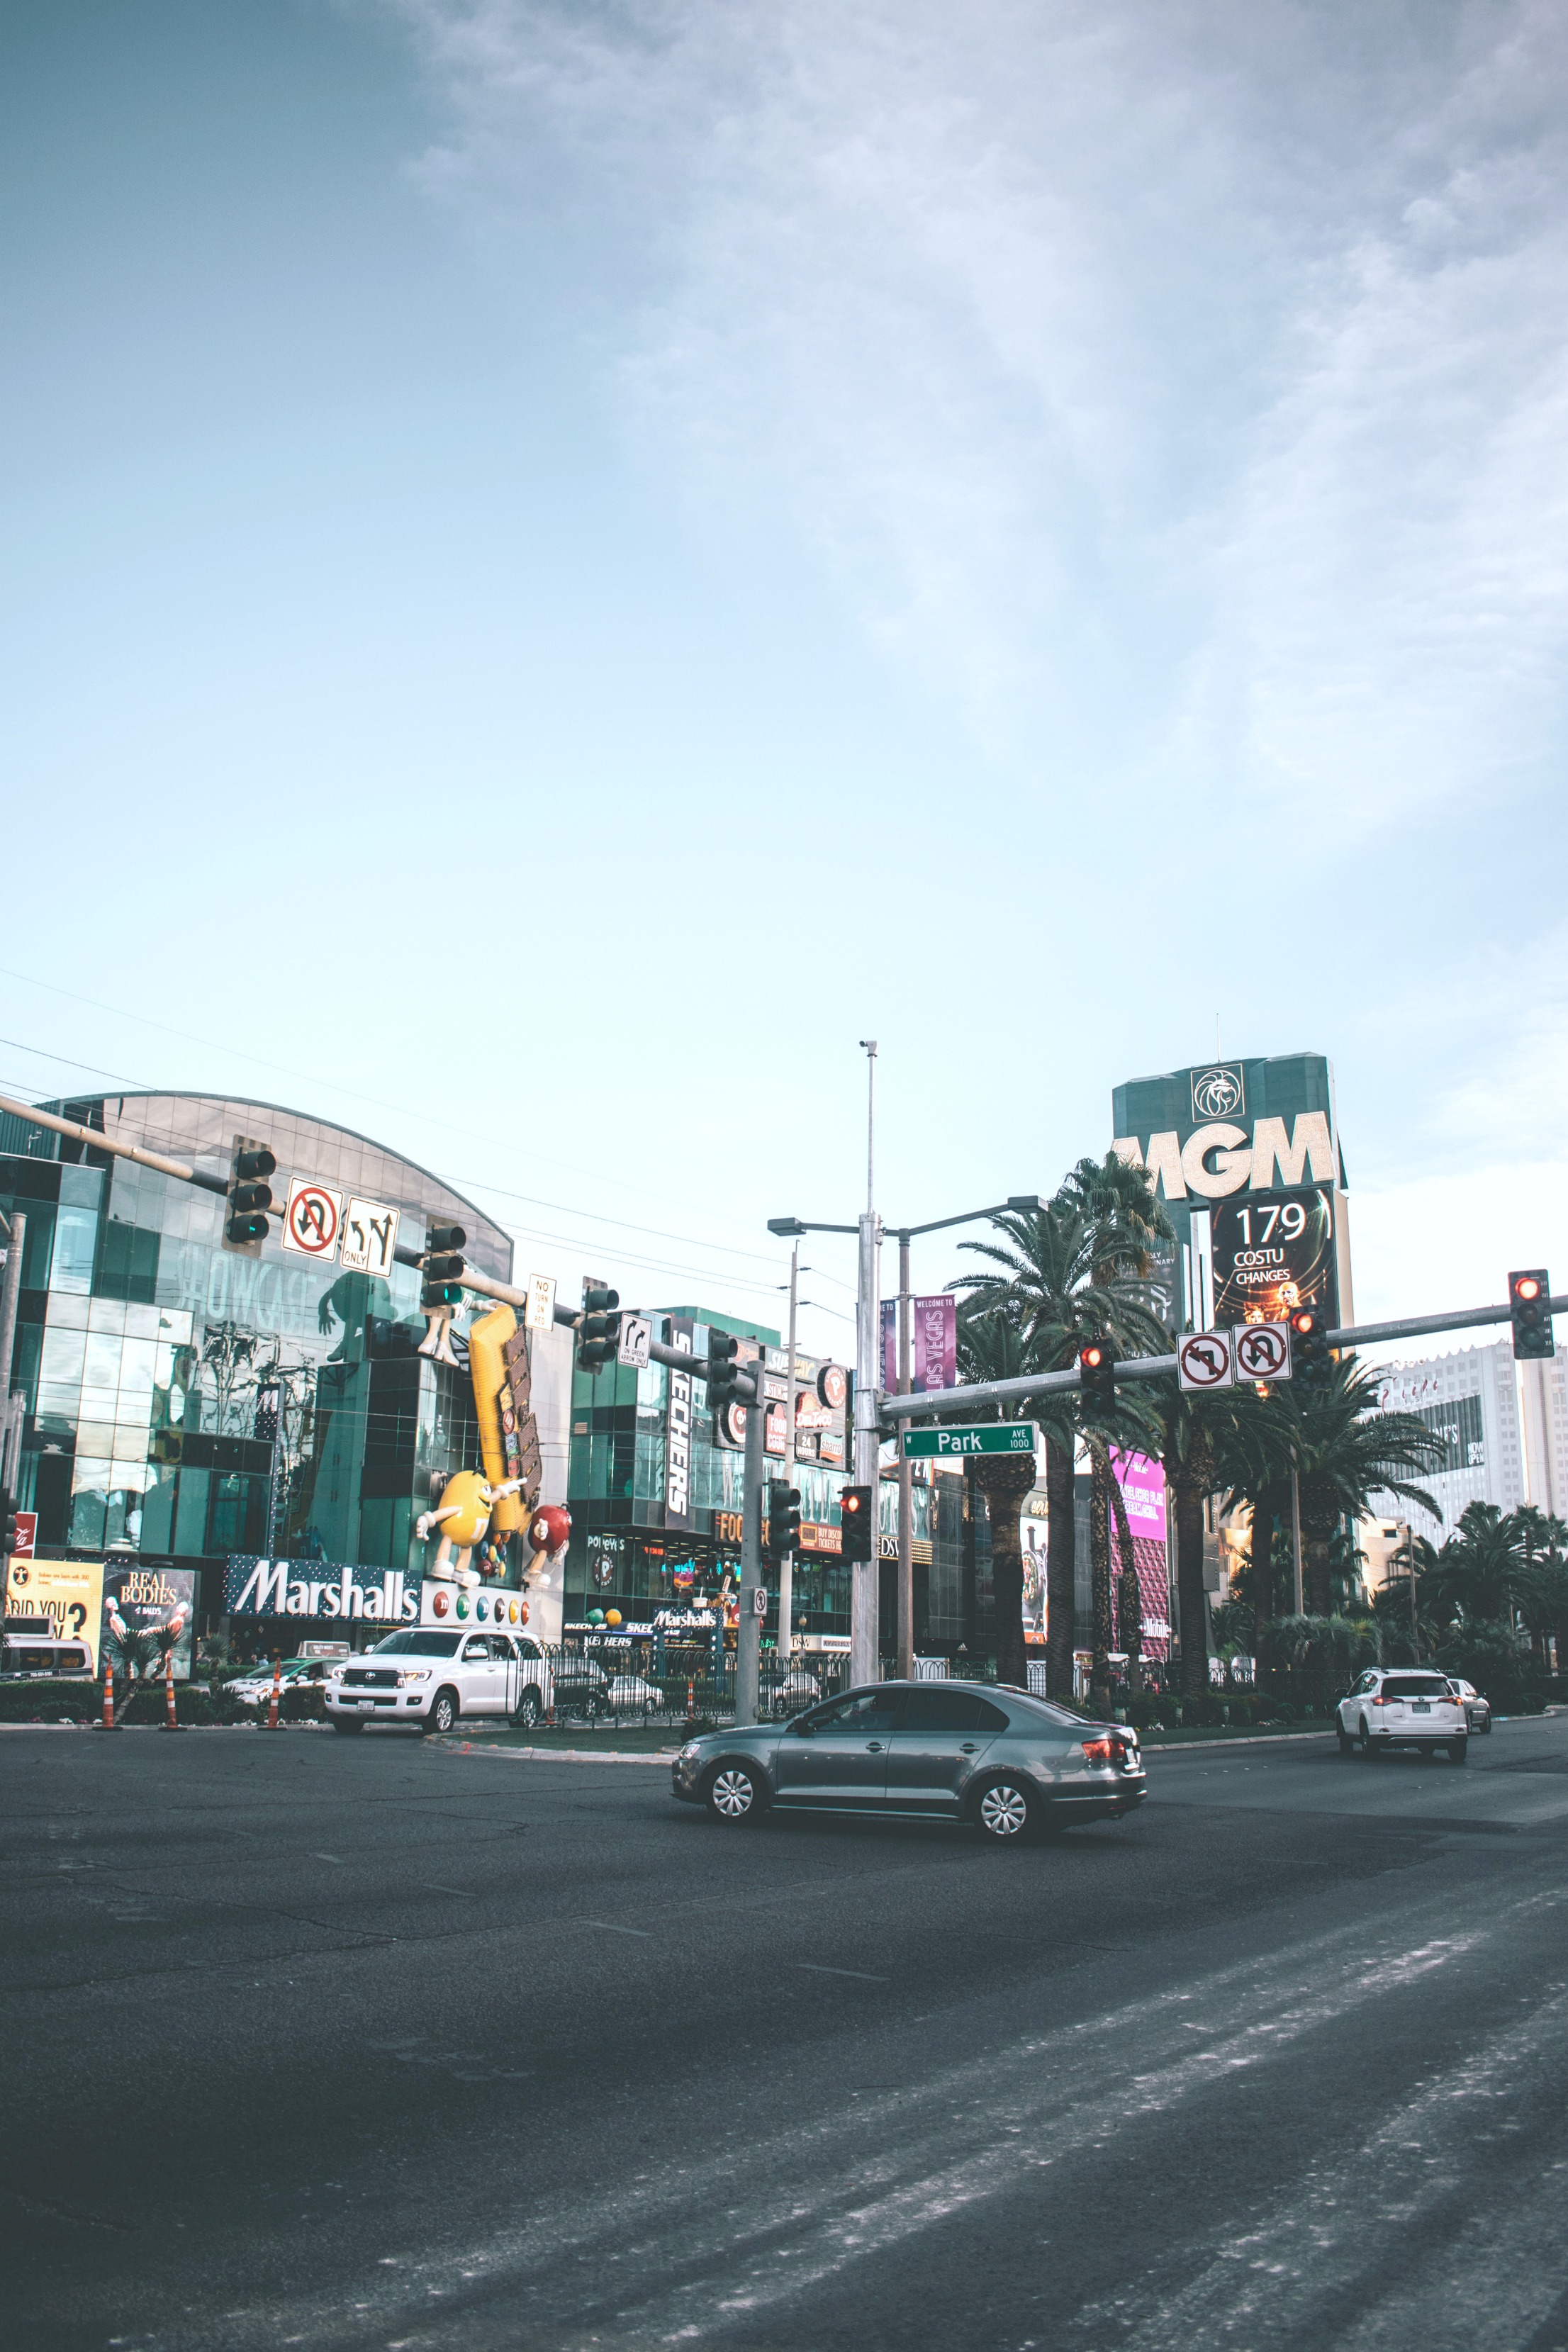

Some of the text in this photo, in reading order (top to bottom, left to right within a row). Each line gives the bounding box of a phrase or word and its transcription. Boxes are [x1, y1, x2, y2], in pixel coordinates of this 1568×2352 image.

[1113, 1111, 1336, 1199] MGM
[1236, 1203, 1306, 1245] 179
[345, 1251, 366, 1265] ONLY
[1234, 1248, 1284, 1266] COSTU
[1236, 1269, 1290, 1284] CHANGES
[537, 1280, 548, 1292] NO
[535, 1293, 548, 1303] TURN
[534, 1316, 544, 1325] RED
[926, 1311, 943, 1361] VEGAS
[768, 1383, 785, 1399] STICK
[768, 1433, 786, 1451] COUR
[802, 1436, 811, 1447] 24
[822, 1440, 841, 1453] sbarro
[906, 1429, 1026, 1452] W Park AVE
[1010, 1439, 1029, 1448] 1000
[1467, 1441, 1484, 1455] NOW
[797, 1446, 815, 1457] HOURS
[1468, 1452, 1484, 1465] OPEN
[719, 1513, 743, 1542] FOO
[818, 1527, 828, 1538] BUY
[818, 1538, 836, 1550] TICKETS
[129, 1572, 170, 1590] REAL
[121, 1586, 177, 1605] BODIES
[234, 1559, 418, 1621] Marshalls
[40, 1600, 66, 1623] YOU
[653, 1611, 717, 1627] Marshalls
